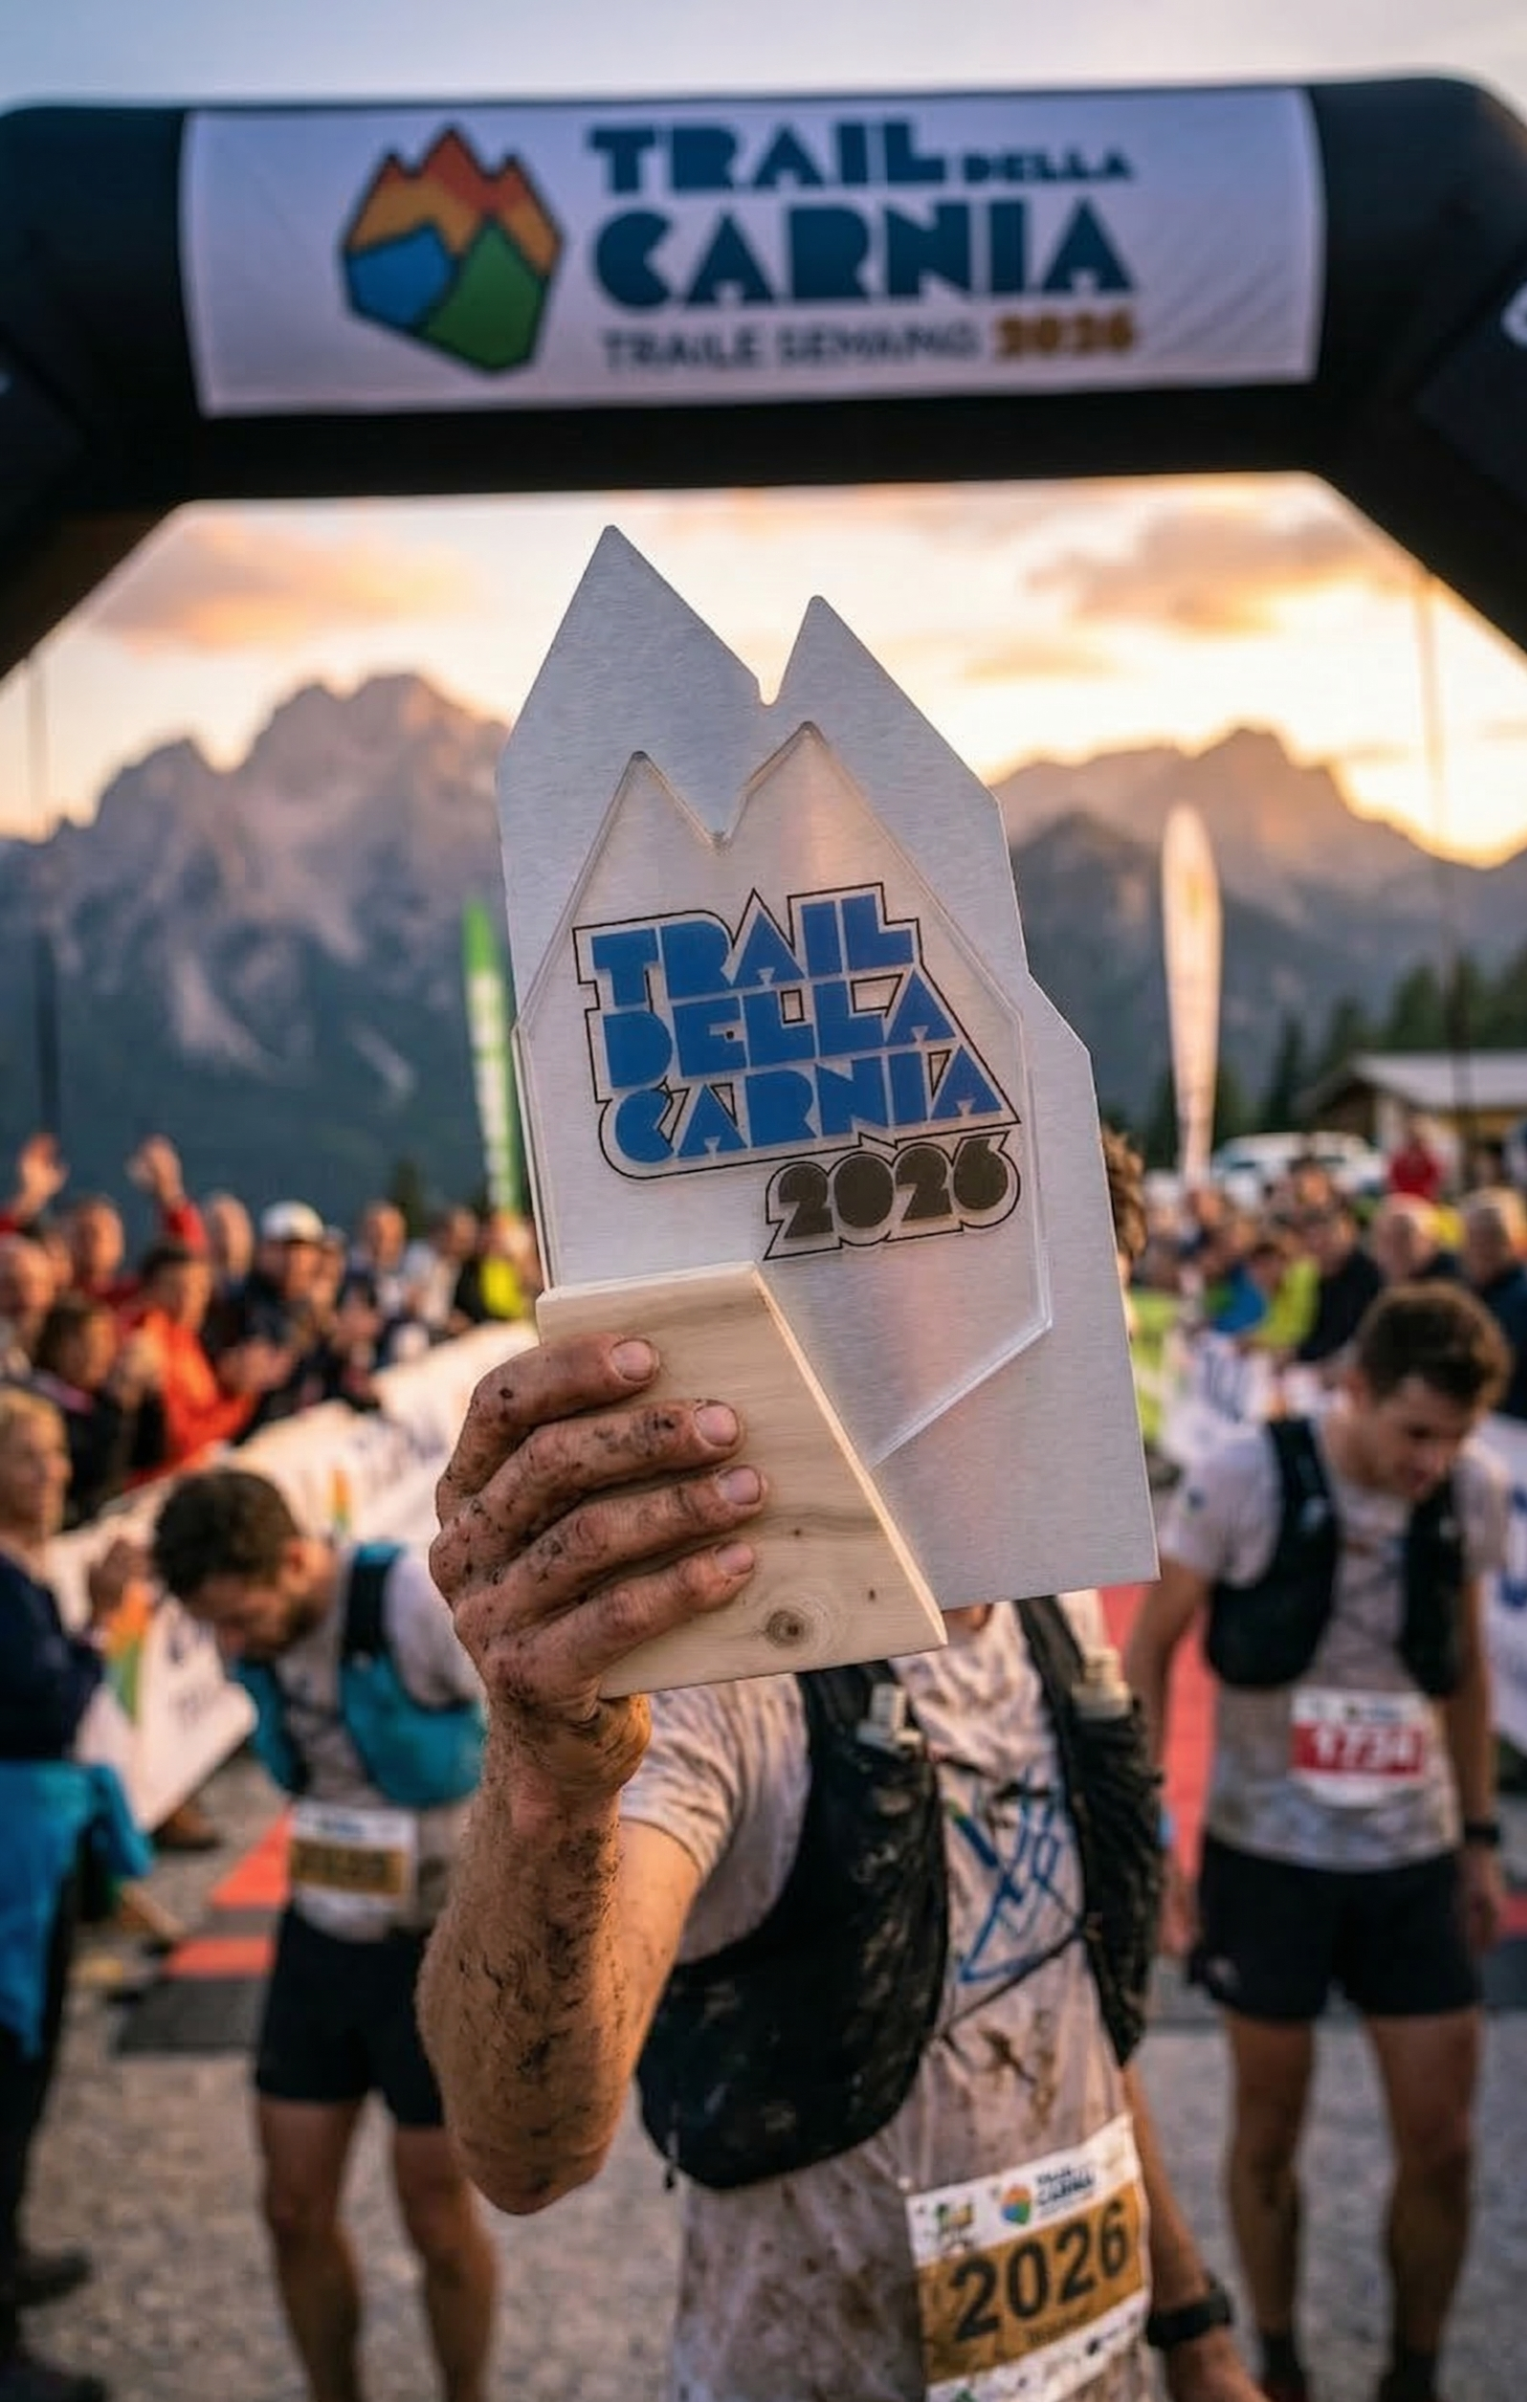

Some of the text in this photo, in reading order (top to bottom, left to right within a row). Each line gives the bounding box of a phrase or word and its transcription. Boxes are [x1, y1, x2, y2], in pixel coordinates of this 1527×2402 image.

[588, 121, 1132, 193] TRAIL DELLA
[593, 197, 1135, 316] CARNIA
[994, 305, 1137, 362] 2026
[592, 893, 914, 1007] TRAIL
[603, 966, 956, 1088] DELLA
[614, 1046, 1003, 1163] CARNIA
[778, 1137, 1010, 1240] 2026
[949, 2199, 1127, 2342] 2026
